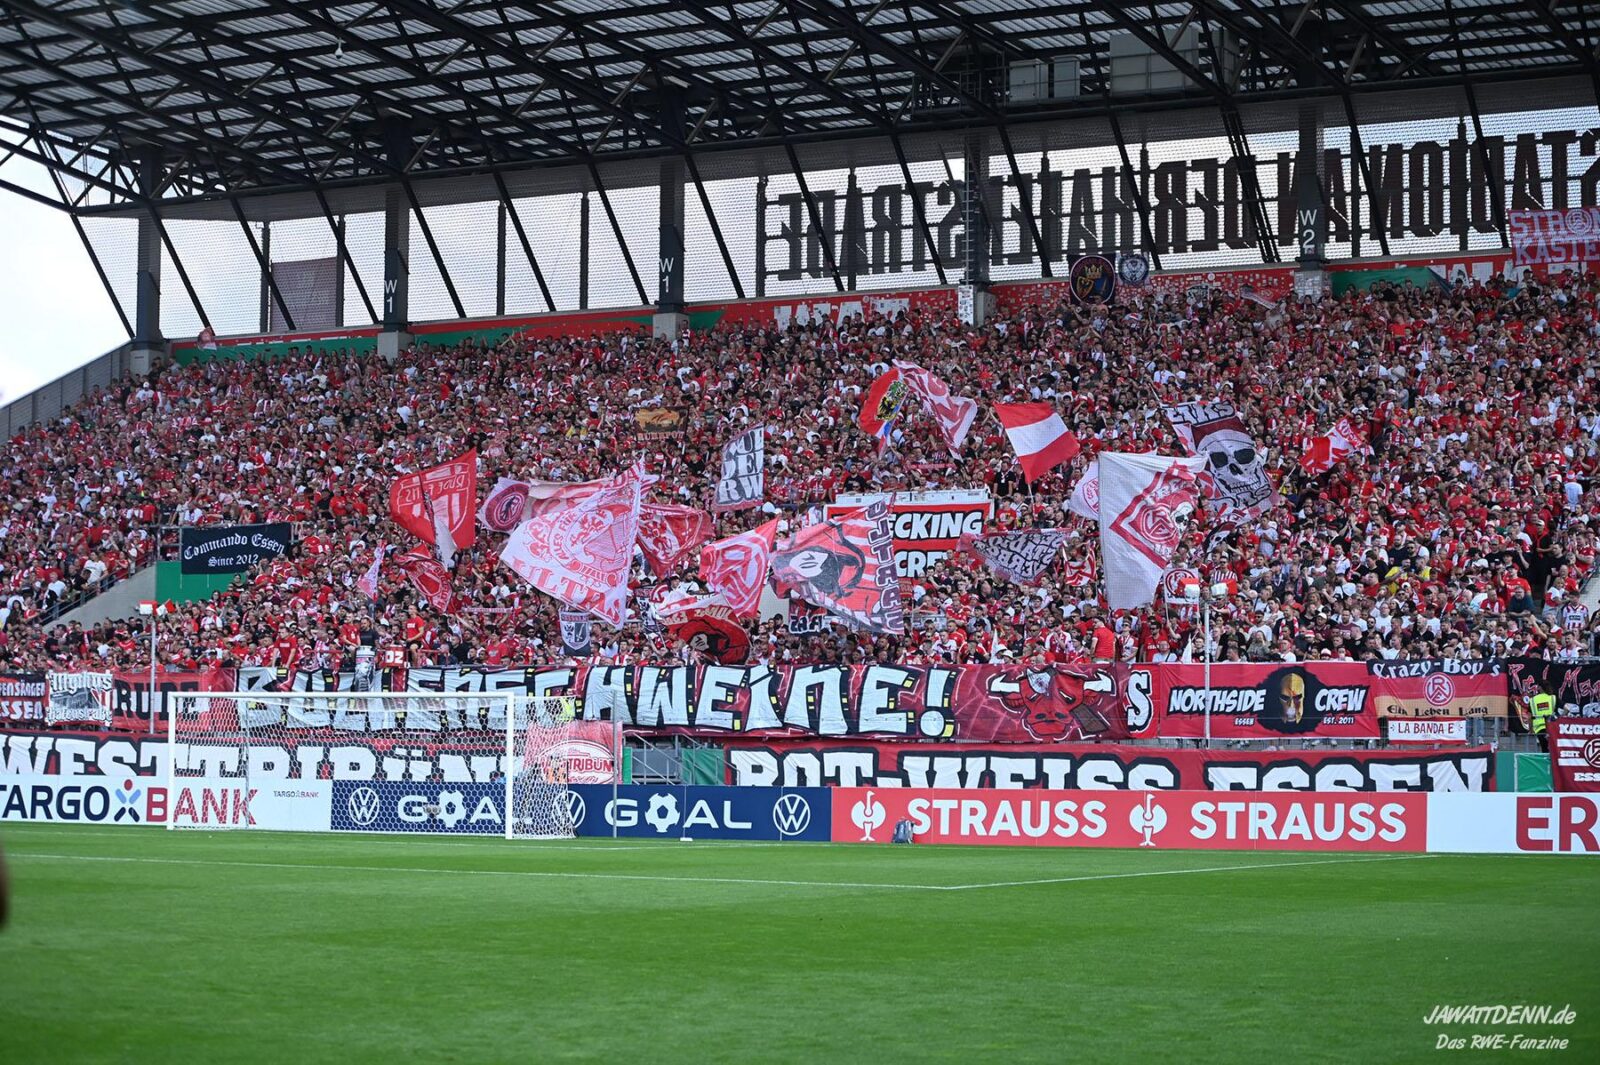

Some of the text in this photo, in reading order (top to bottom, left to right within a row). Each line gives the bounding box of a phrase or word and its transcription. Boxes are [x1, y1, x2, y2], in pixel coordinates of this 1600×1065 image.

[1300, 209, 1317, 226] W
[1303, 229, 1315, 248] 2
[660, 257, 674, 272] W
[384, 280, 397, 294] W
[662, 275, 669, 293] 1
[386, 296, 393, 313] 1
[183, 533, 285, 560] Commando Essen
[208, 554, 258, 567] Since 2012
[895, 550, 950, 578] CRE
[1169, 688, 1366, 712] NORTHSIDE CREW
[0, 700, 43, 720] SSEN
[1398, 722, 1454, 734] LA BANDA E
[0, 785, 110, 820] ARGO
[908, 798, 1107, 839] STRAUSS
[1190, 801, 1407, 842] STRAUSS
